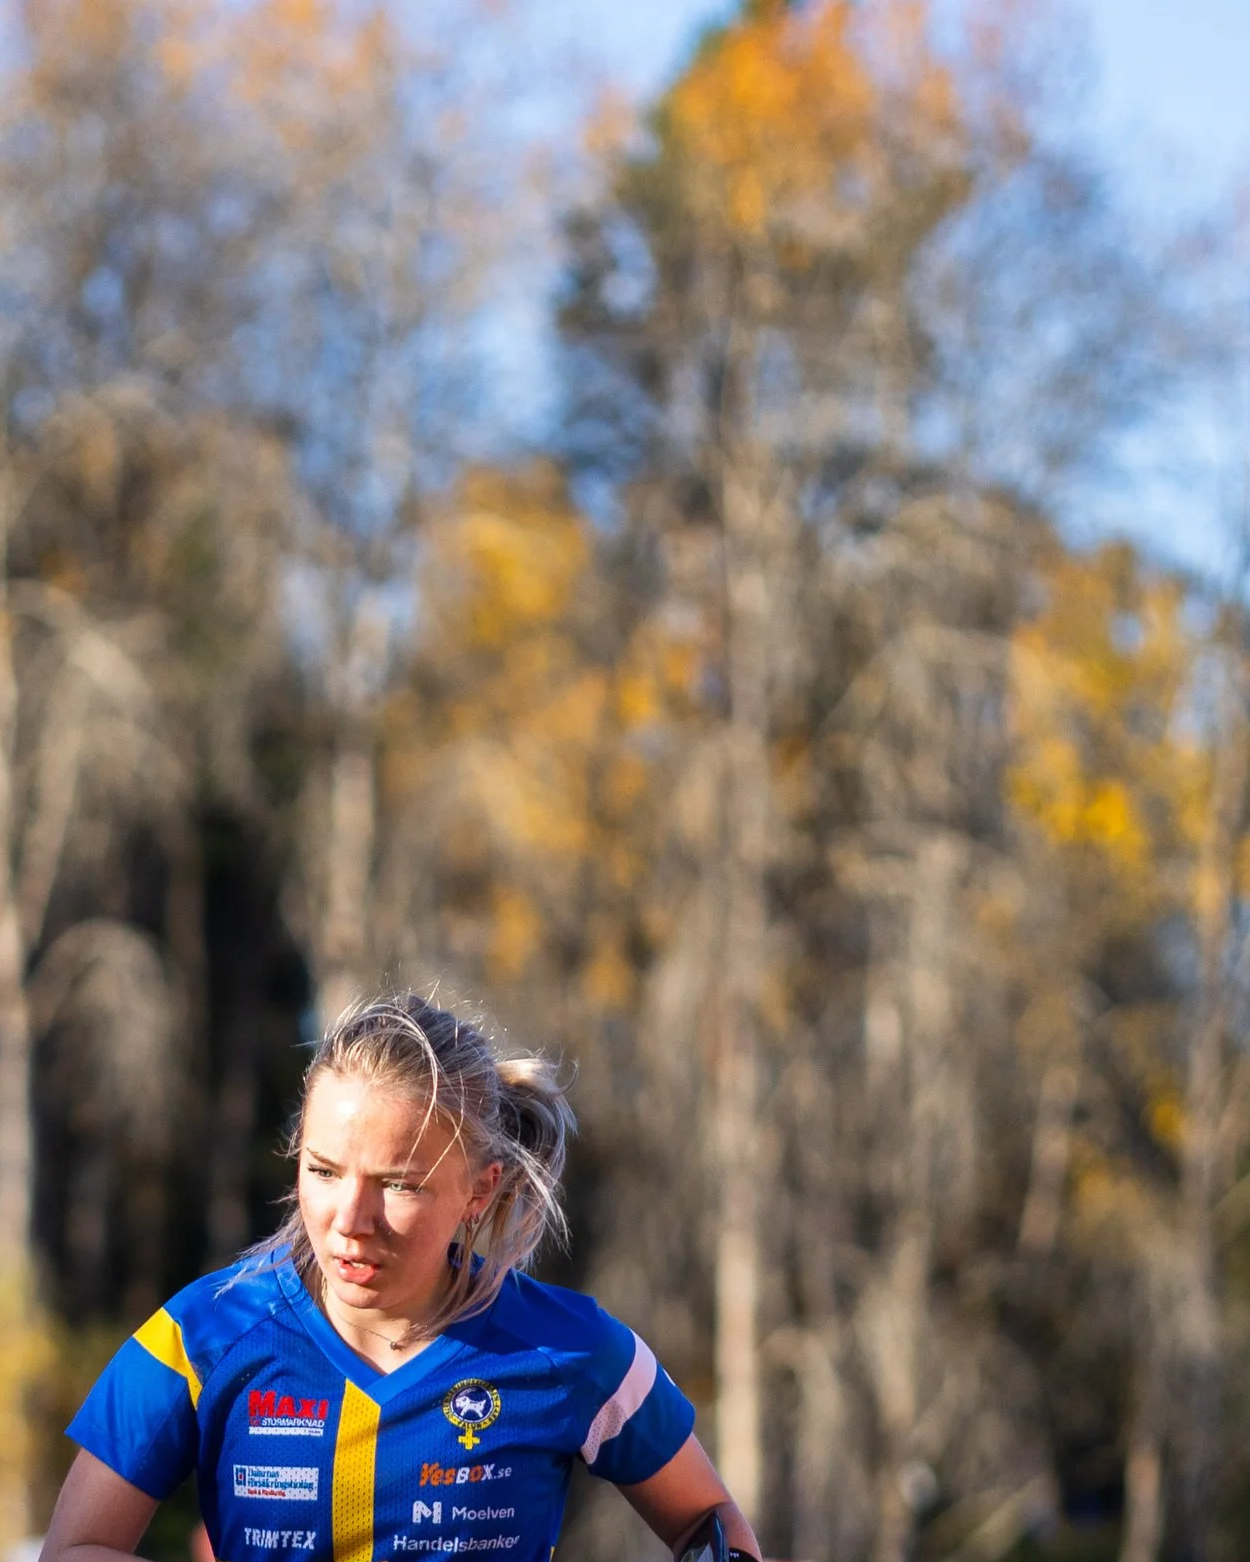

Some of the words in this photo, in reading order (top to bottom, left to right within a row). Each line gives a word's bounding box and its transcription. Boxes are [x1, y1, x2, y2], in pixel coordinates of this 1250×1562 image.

[249, 1390, 329, 1419] MAXI
[261, 1417, 325, 1428] STORMARKNAD
[452, 1506, 515, 1520] Moelven
[244, 1527, 316, 1550] TRIMTEX
